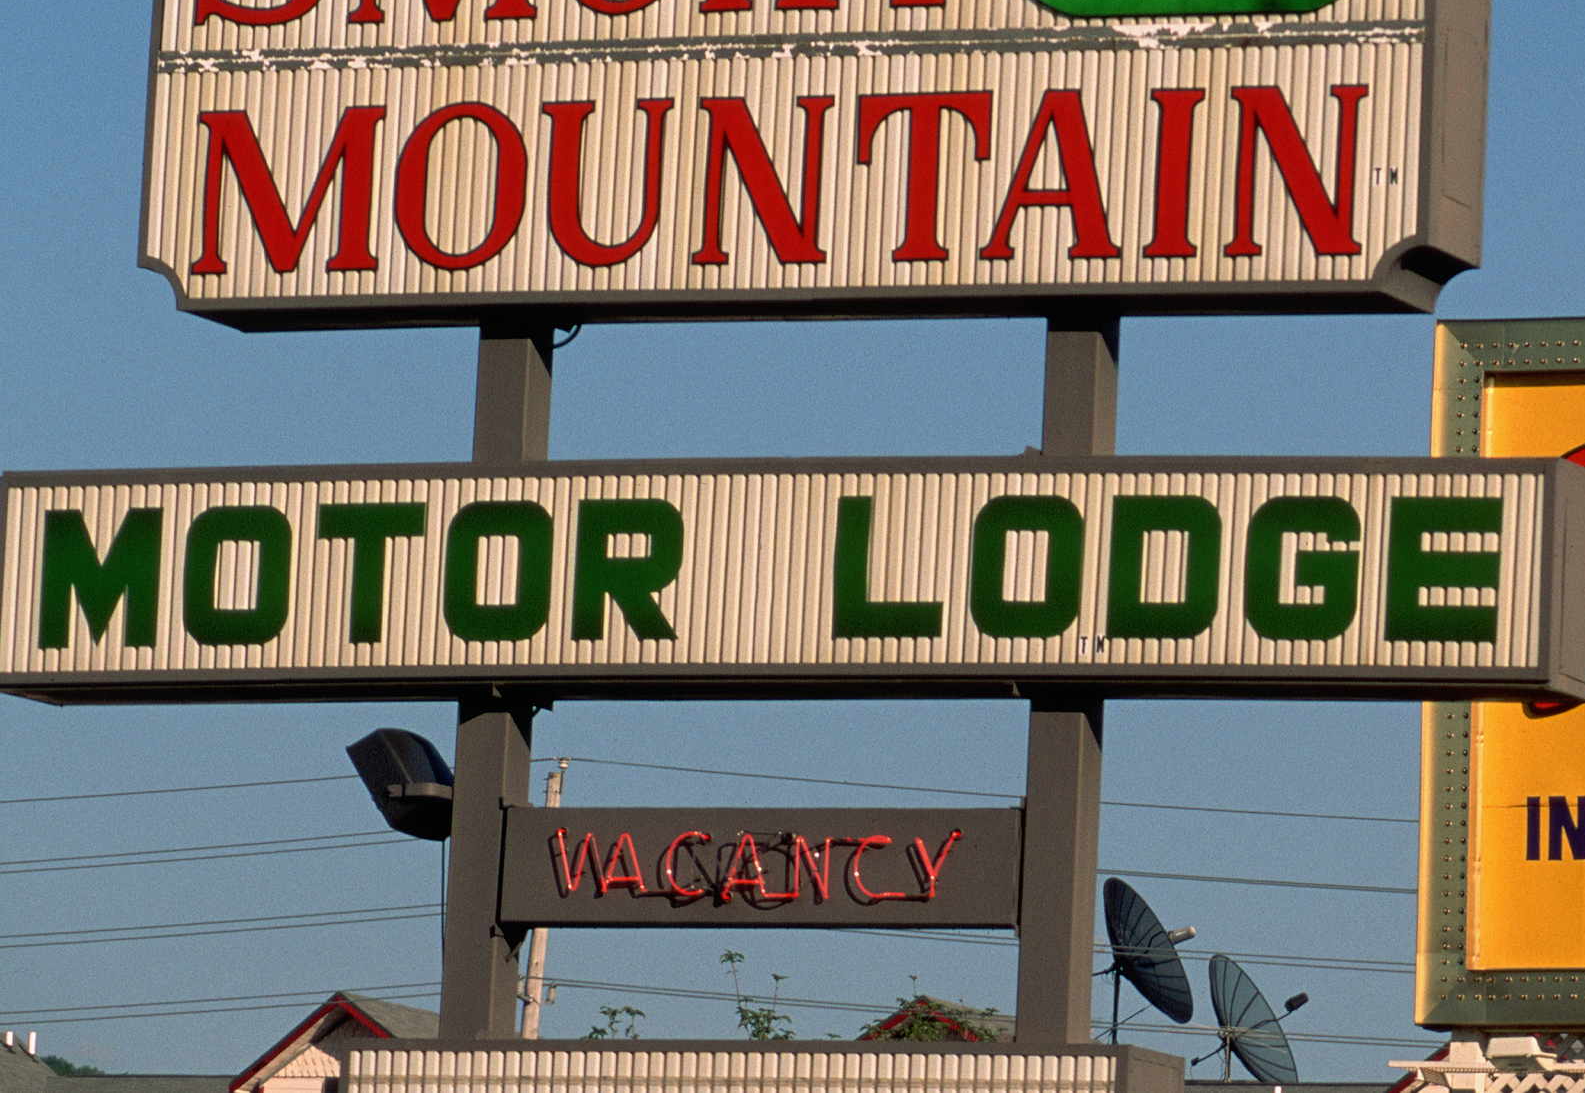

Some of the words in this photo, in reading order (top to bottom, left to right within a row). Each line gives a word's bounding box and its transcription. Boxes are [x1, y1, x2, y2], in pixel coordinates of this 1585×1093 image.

[190, 83, 1370, 275] MOUNTAIN
[1374, 167, 1398, 185] TM
[39, 498, 684, 650] MOTOR
[832, 495, 1504, 642] LODGE
[554, 827, 962, 900] VACANCY
